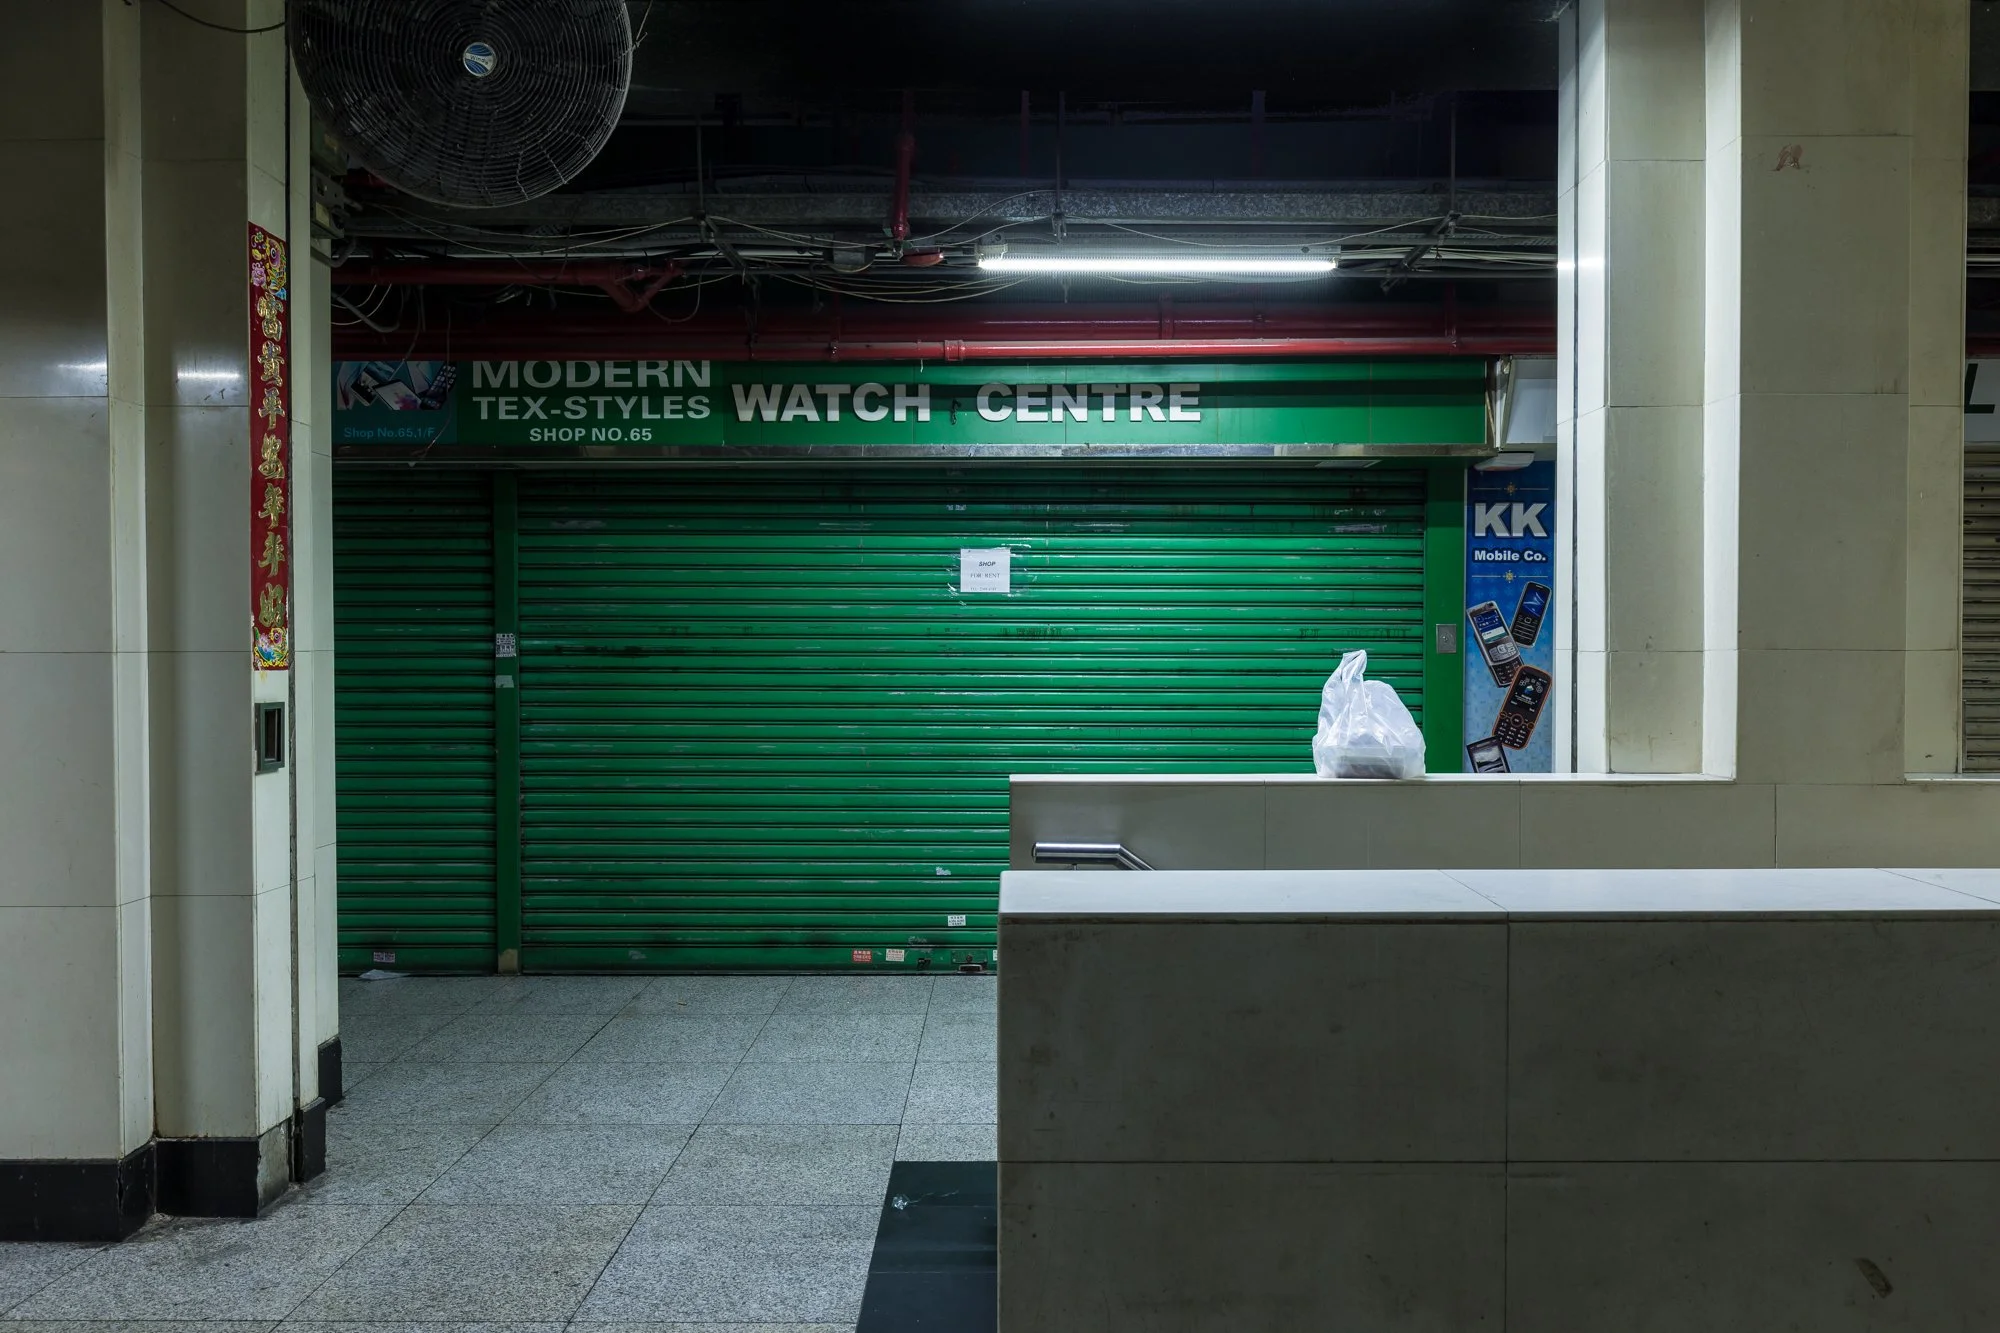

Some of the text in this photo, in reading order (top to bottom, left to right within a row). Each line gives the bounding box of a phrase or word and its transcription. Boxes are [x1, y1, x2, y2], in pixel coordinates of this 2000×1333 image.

[472, 360, 711, 388] MODERN
[472, 395, 711, 420] TEX-STYLES
[732, 383, 1202, 422] WATCH CENTRE
[344, 427, 374, 440] Shop
[529, 427, 653, 442] SHOP NO.65
[1474, 503, 1548, 537] KK
[1474, 550, 1546, 561] Mobile Co.
